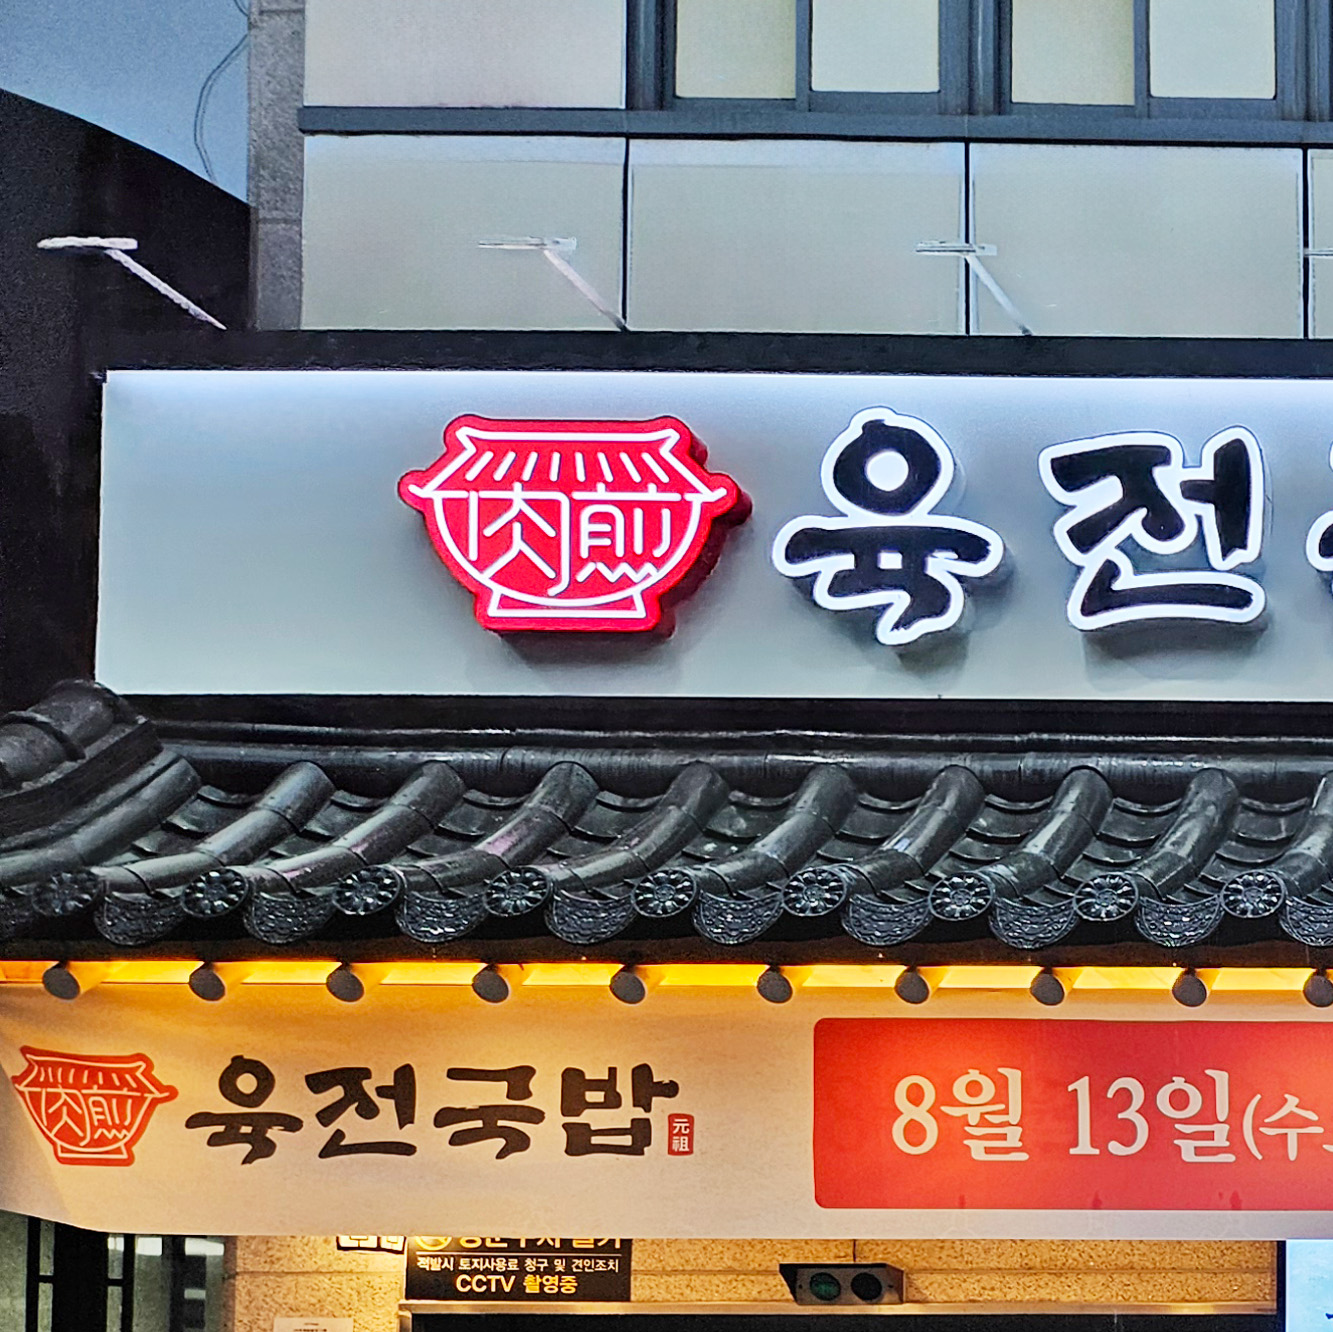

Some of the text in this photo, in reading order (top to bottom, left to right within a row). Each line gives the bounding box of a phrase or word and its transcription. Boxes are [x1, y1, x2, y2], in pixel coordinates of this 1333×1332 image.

[184, 1053, 680, 1166] 육전국밥
[891, 1067, 1030, 1162] 8월
[671, 1117, 691, 1154] 元祖
[416, 1257, 619, 1273] 적발시 토지사용료 청구 및 견인조치
[455, 1274, 578, 1294] CCTV 촬영중
